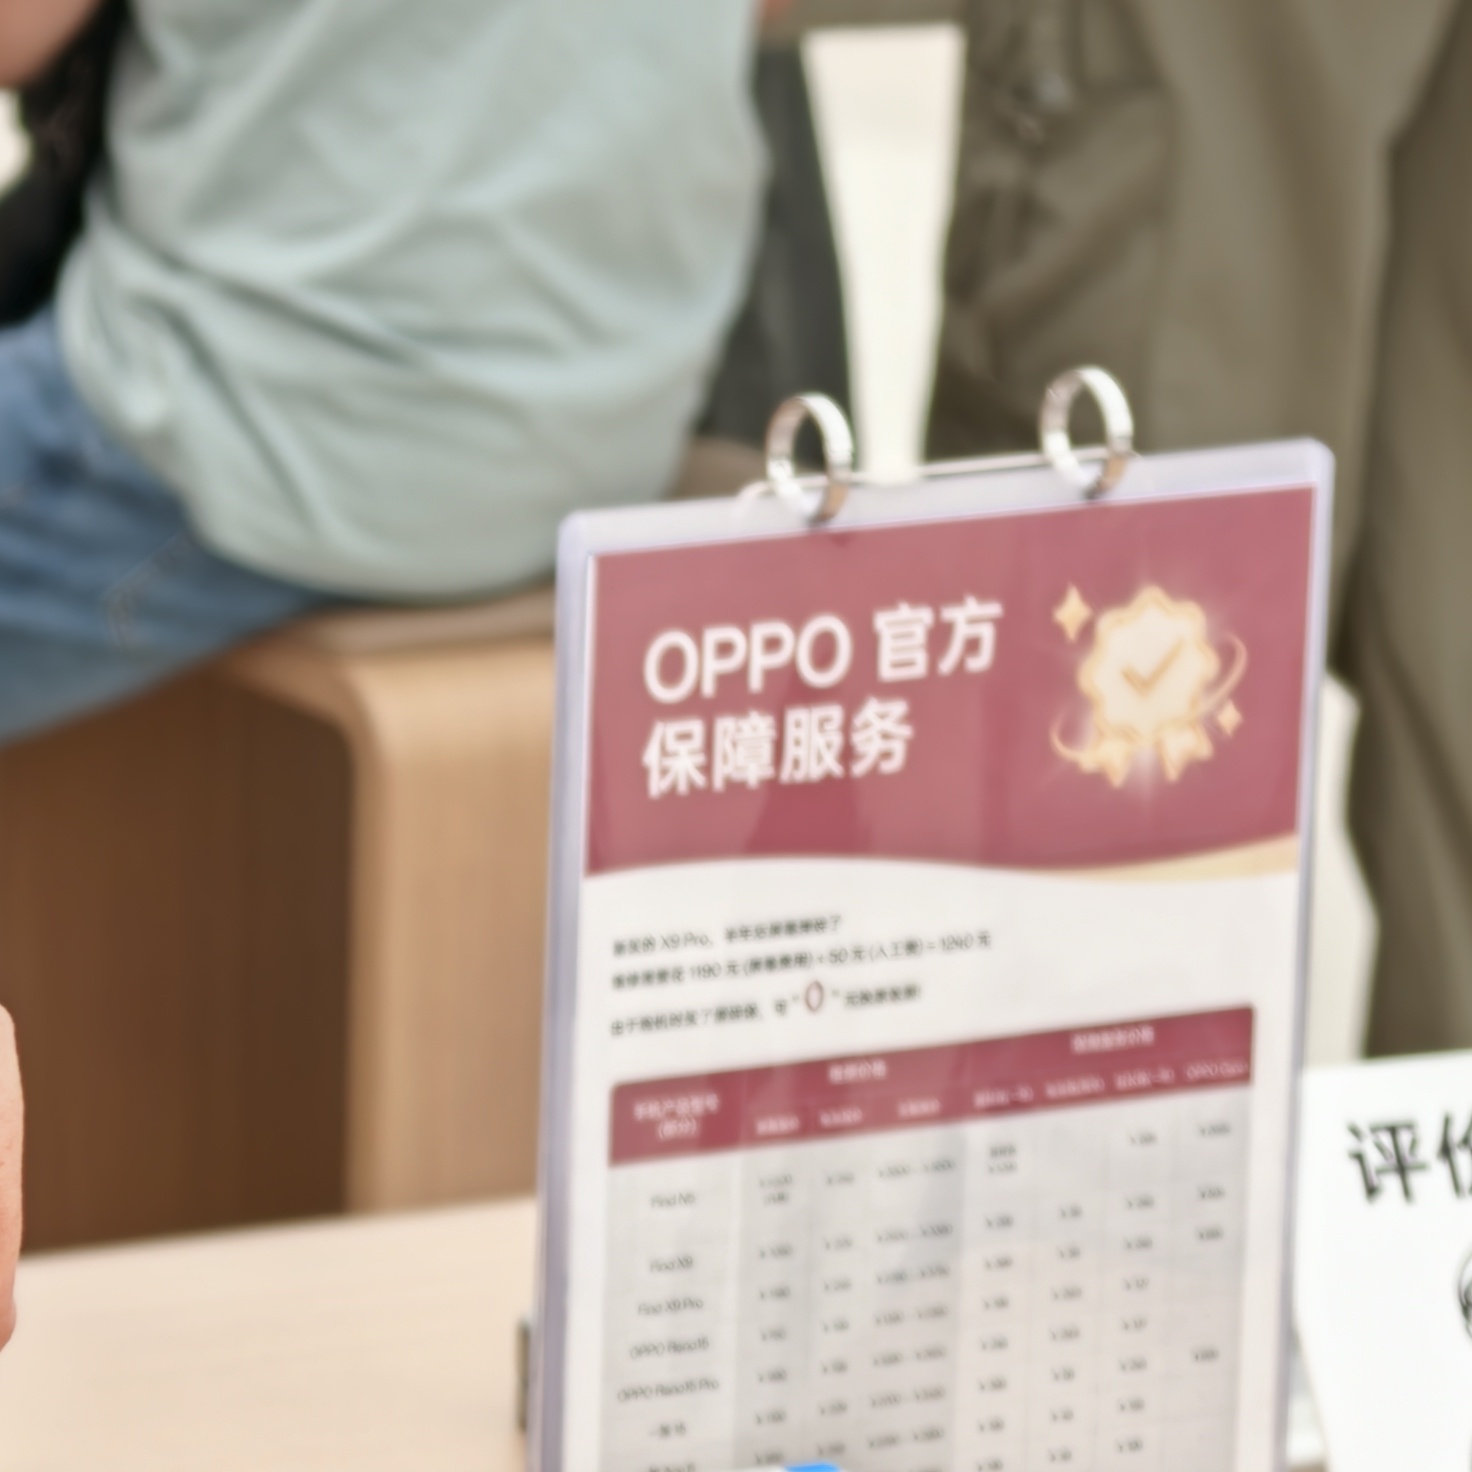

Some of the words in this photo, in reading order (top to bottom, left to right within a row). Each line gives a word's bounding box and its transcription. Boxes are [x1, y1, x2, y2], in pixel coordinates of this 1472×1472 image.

[643, 614, 852, 704] OPPO
[872, 595, 1004, 683] 官方
[641, 695, 915, 800] 保障服务
